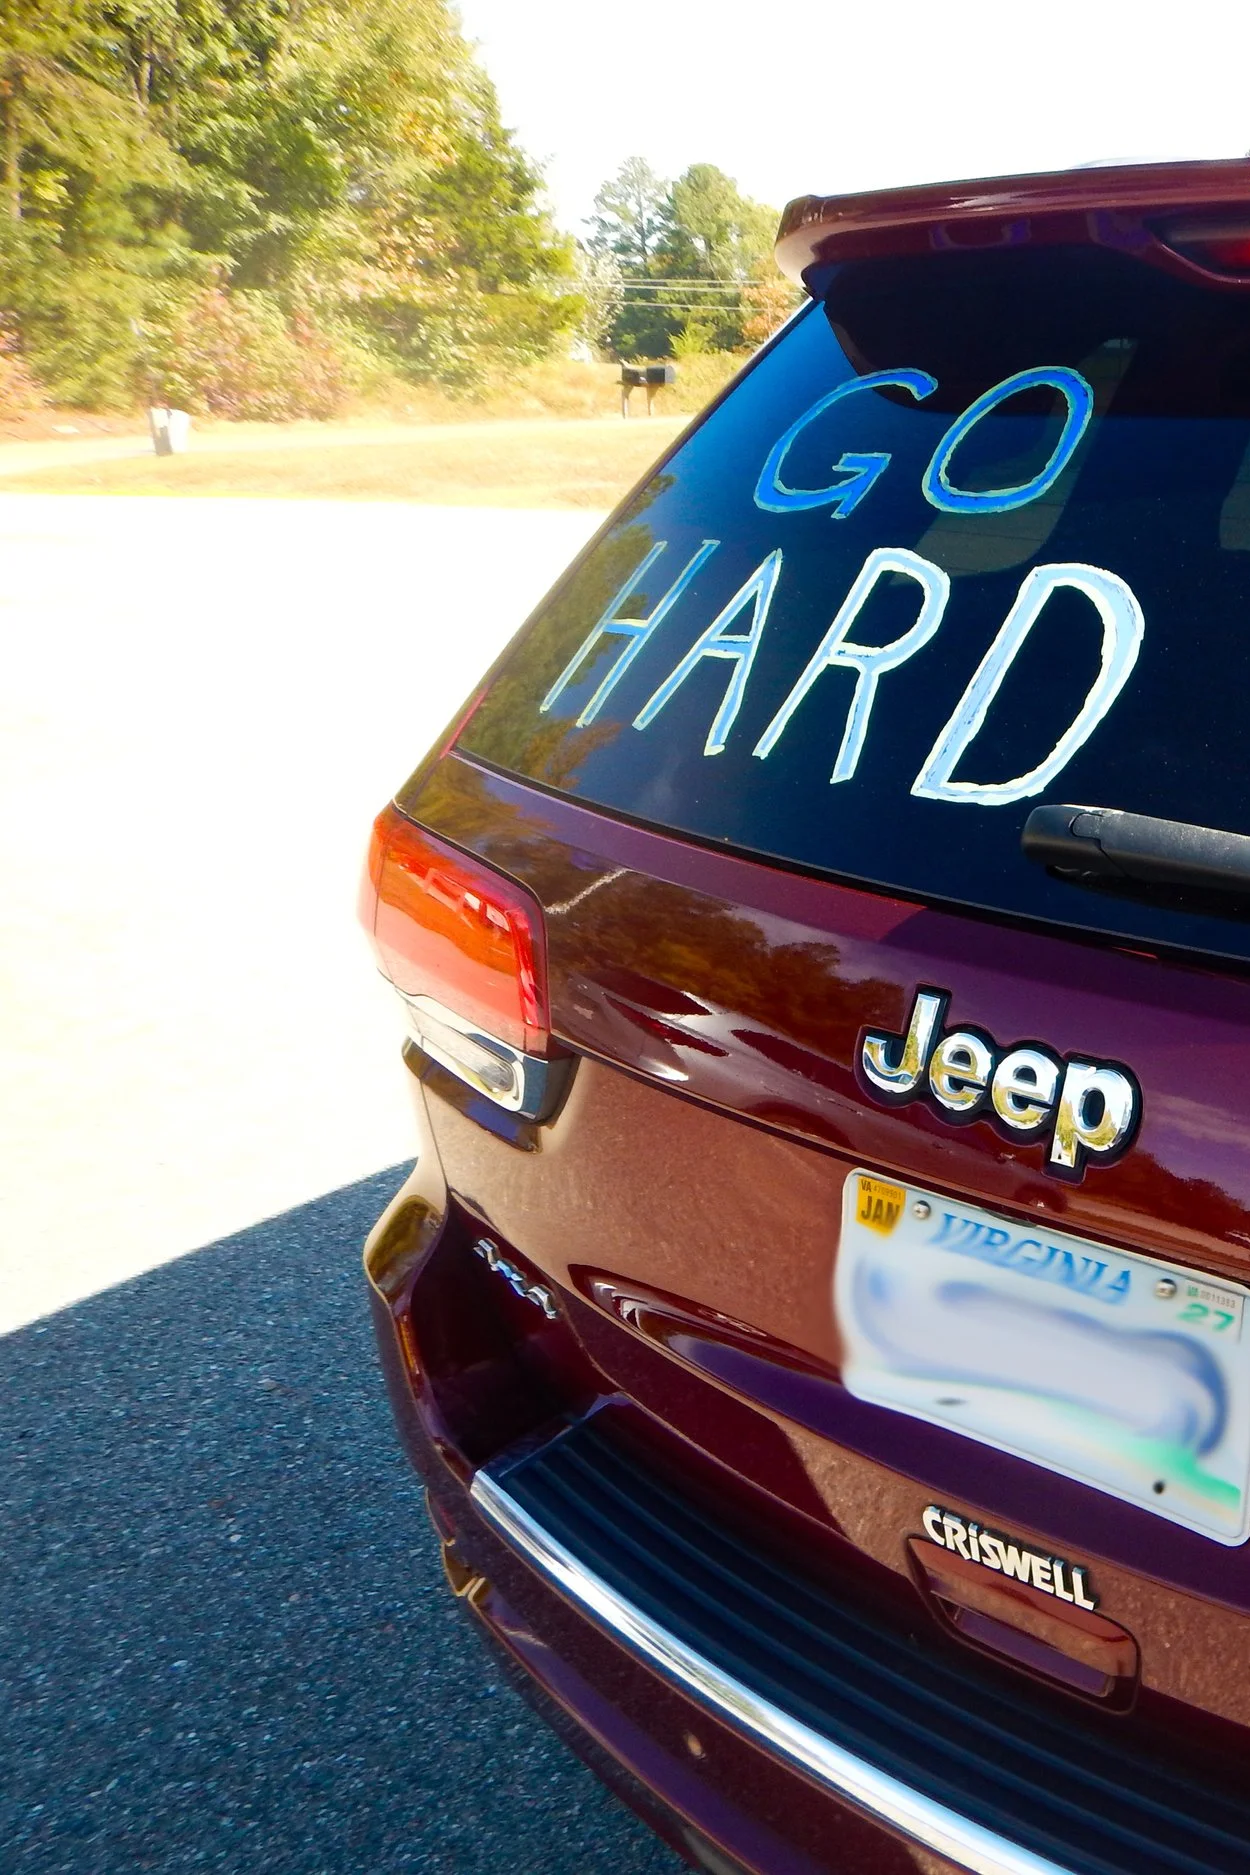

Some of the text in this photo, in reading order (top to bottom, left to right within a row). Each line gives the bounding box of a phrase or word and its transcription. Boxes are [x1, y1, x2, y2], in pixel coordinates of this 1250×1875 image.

[753, 365, 1094, 519] GO
[539, 538, 1146, 806] HARD
[862, 992, 1134, 1169] Jeep
[861, 1179, 872, 1192] VA
[861, 1195, 901, 1229] JAN
[930, 1212, 1132, 1304] VIRGINIA
[1178, 1302, 1235, 1332] 27
